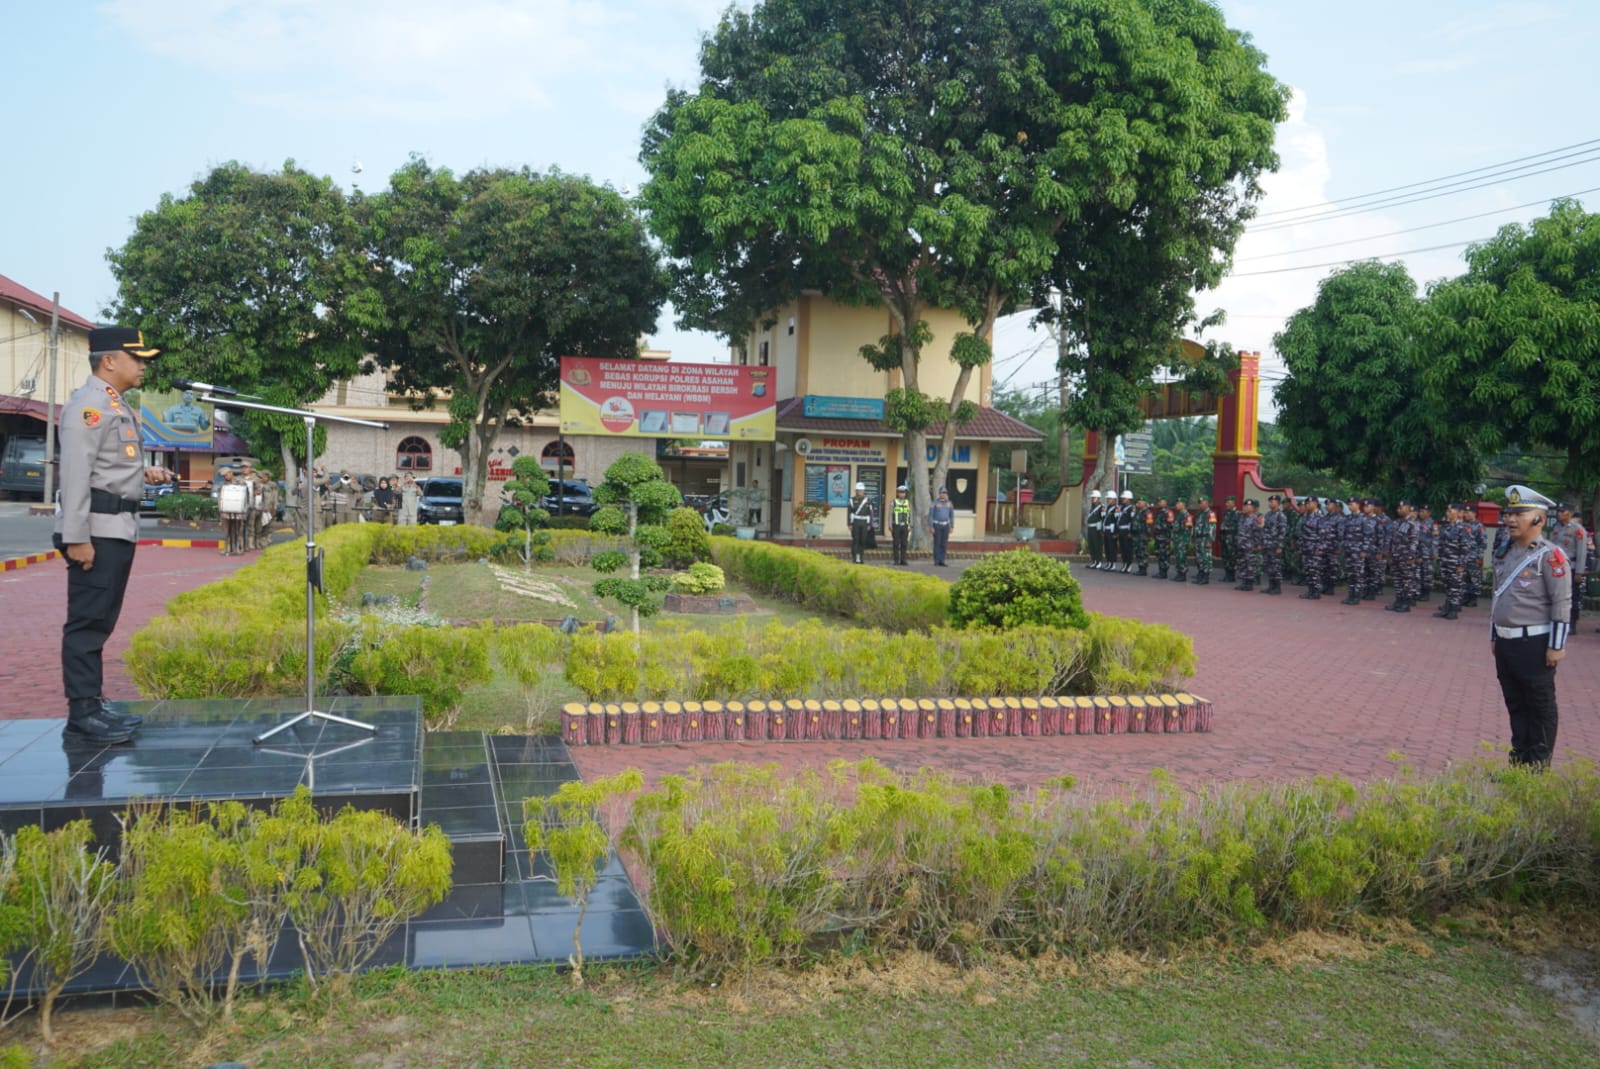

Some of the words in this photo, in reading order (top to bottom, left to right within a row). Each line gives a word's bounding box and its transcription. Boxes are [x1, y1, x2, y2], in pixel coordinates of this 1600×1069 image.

[600, 363, 635, 371] SELAMAT
[638, 365, 669, 373] DATANG
[705, 368, 739, 376] WILAYAH
[604, 372, 630, 380] BEBAS
[633, 373, 667, 382] KORUPSI
[670, 375, 699, 383] POLRES
[702, 377, 733, 385] ASAHAN
[600, 381, 631, 389] MENUJU
[634, 383, 667, 391] WILAYAH
[669, 384, 709, 393] BIROKRASI
[711, 386, 738, 394] BERSIH
[627, 391, 643, 399] DAN
[645, 392, 681, 401] MELAYANI
[823, 438, 871, 448] PROPAM
